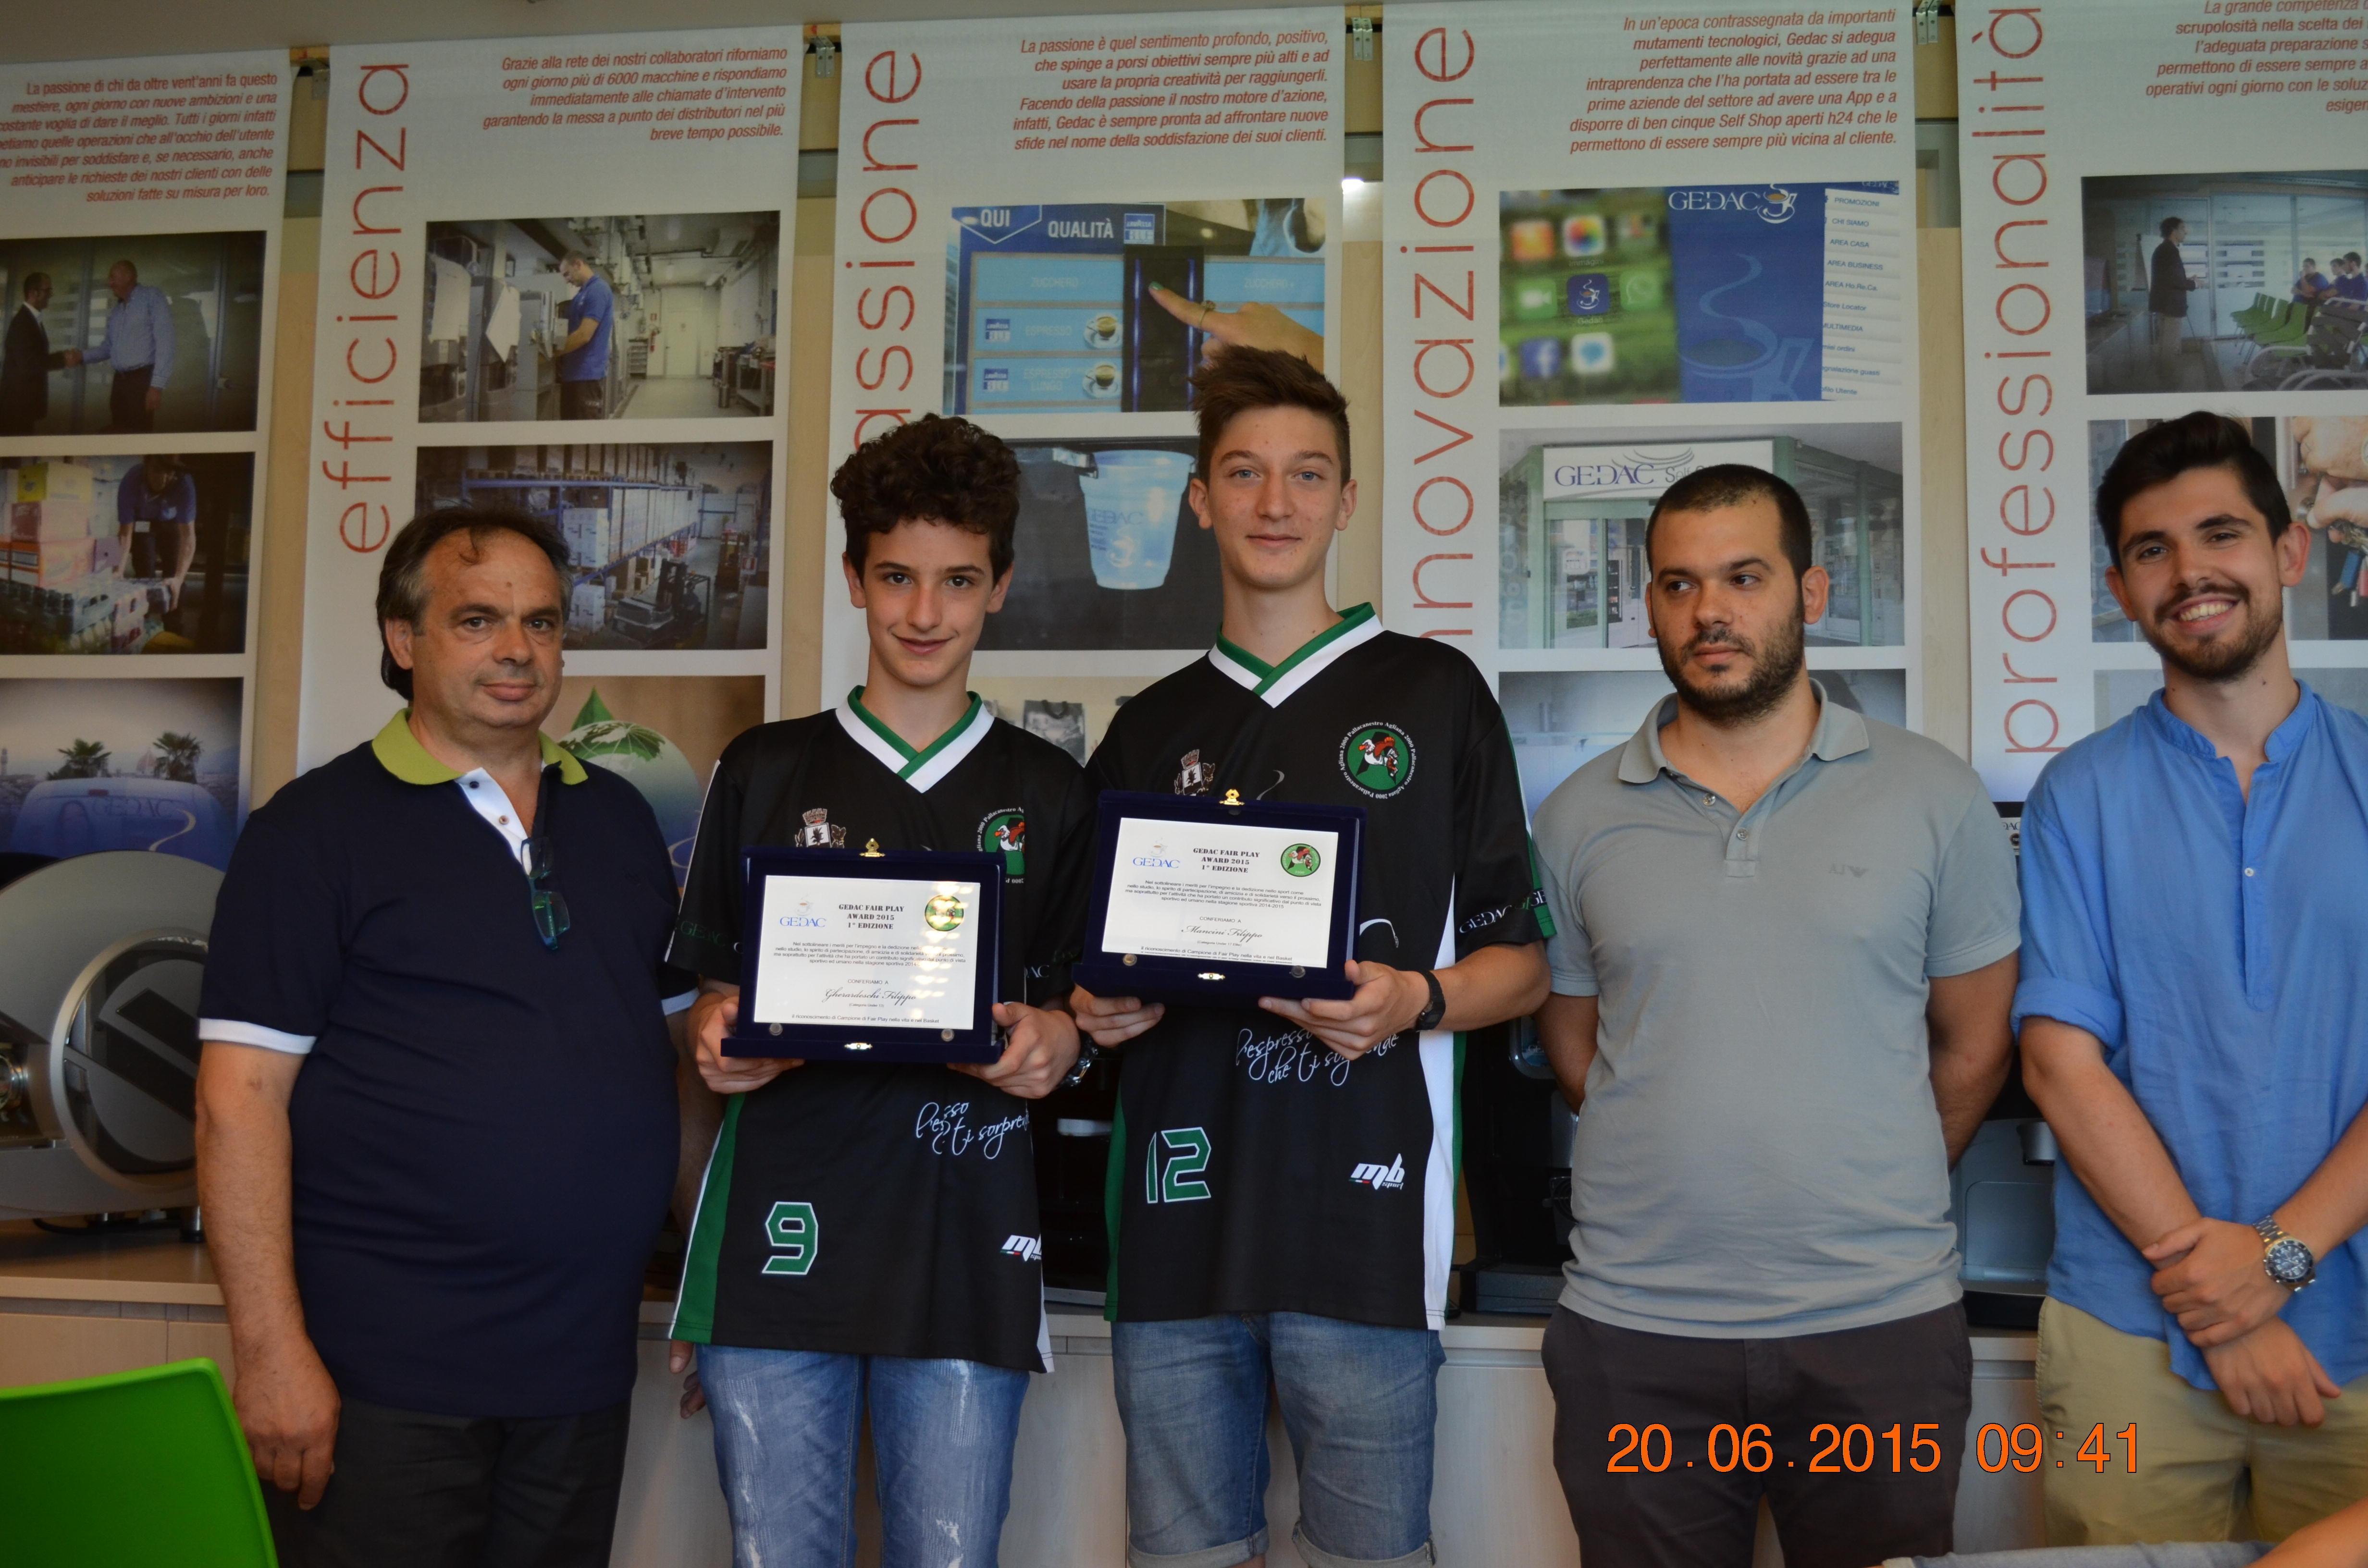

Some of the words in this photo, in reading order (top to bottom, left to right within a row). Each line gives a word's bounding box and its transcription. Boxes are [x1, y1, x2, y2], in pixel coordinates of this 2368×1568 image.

[1624, 17, 1636, 30] In
[1640, 16, 1700, 33] un'epoca
[1703, 12, 1804, 29] contrassegnata
[1807, 11, 1825, 25] da
[1827, 9, 1896, 27] importanti
[2175, 19, 2257, 36] scrupolosità
[2261, 19, 2294, 32] nella
[2297, 18, 2338, 31] scelta
[2342, 16, 2363, 30] dei
[1021, 39, 1036, 53] La
[1038, 38, 1095, 55] passione
[1098, 37, 1106, 50] è
[1110, 36, 1137, 52] quel
[1139, 34, 1209, 49] sentimento
[1211, 32, 1271, 49] profondo,
[1275, 30, 1328, 47] positivo,
[1633, 36, 1704, 50] mutamenti
[1708, 33, 1781, 49] tecnologici,
[1787, 32, 1828, 46] Gedac
[1831, 31, 1843, 44] si
[1846, 30, 1896, 46] adegua
[2195, 39, 2266, 55] l'adeguata
[2269, 37, 2358, 54] preparazione
[502, 57, 538, 71] Grazie
[541, 55, 562, 69] alla
[565, 55, 589, 68] rete
[592, 54, 610, 67] dei
[613, 52, 647, 66] nostri
[649, 49, 724, 65] collaboratori
[726, 47, 788, 61] riforniamo
[1639, 54, 1732, 72] perfettamente
[1736, 53, 1760, 67] alle
[1763, 51, 1803, 66] novità
[1806, 51, 1847, 68] grazie
[1850, 50, 1868, 63] ad
[1871, 51, 1896, 63] una
[2157, 61, 2235, 77] permettono
[2239, 59, 2252, 73] di
[2256, 61, 2301, 73] essere
[2305, 60, 2356, 73] sempre
[26, 83, 40, 95] La
[43, 81, 92, 97] passione
[94, 79, 105, 92] di
[107, 79, 123, 92] chi
[126, 78, 141, 91] da
[143, 77, 169, 91] oltre
[172, 74, 222, 89] vent'anni
[225, 74, 236, 86] fa
[240, 73, 278, 88] questo
[530, 91, 629, 106] immediatamente
[631, 90, 654, 103] alle
[656, 88, 712, 102] chiamate
[715, 86, 787, 100] d'intervento
[1020, 97, 1073, 110] Facendo
[1076, 95, 1107, 109] della
[1108, 94, 1166, 110] passione
[1168, 93, 1177, 106] il
[1179, 92, 1220, 105] nostro
[1222, 91, 1268, 104] motore
[1271, 89, 1327, 103] d'azione,
[1013, 117, 1051, 131] infatti,
[1056, 116, 1096, 129] Gedac
[1098, 114, 1107, 128] è
[1110, 116, 1158, 130] sempre
[1159, 112, 1201, 128] pronta
[1204, 111, 1221, 124] ad
[1224, 110, 1286, 124] affrontare
[1290, 110, 1329, 122] nuove
[650, 128, 684, 141] breve
[687, 127, 725, 141] tempo
[727, 123, 783, 141] possibile.
[1668, 192, 1760, 211] GEDAC
[1834, 197, 1880, 207] PROMOZIONI
[980, 208, 1011, 228] QUI
[1048, 218, 1114, 239] QUALITÀ
[846, 50, 922, 452] assione
[1848, 261, 1883, 270] BUSINESS
[322, 64, 409, 553] efficienza
[1400, 27, 1476, 639] novazione
[1971, 8, 2068, 753] professionalità
[1554, 463, 1655, 487] GEDAC
[1340, 736, 1349, 749] 2000
[1347, 721, 1383, 737] Pallacanestro
[1385, 722, 1405, 735] Agliana
[1404, 735, 1414, 748] 2000
[1404, 748, 1417, 785] Pallacanestro
[1343, 772, 1374, 797] Pallacanestro
[983, 808, 1016, 822] Pallacanestro
[1133, 857, 1180, 869] GEDAC
[780, 917, 826, 928] GEDAC
[1181, 925, 1226, 935] Mancini
[1227, 928, 1263, 943] Filippo
[882, 991, 916, 1005] Filippo
[1146, 1127, 1211, 1203] 12
[762, 1201, 818, 1274] 9
